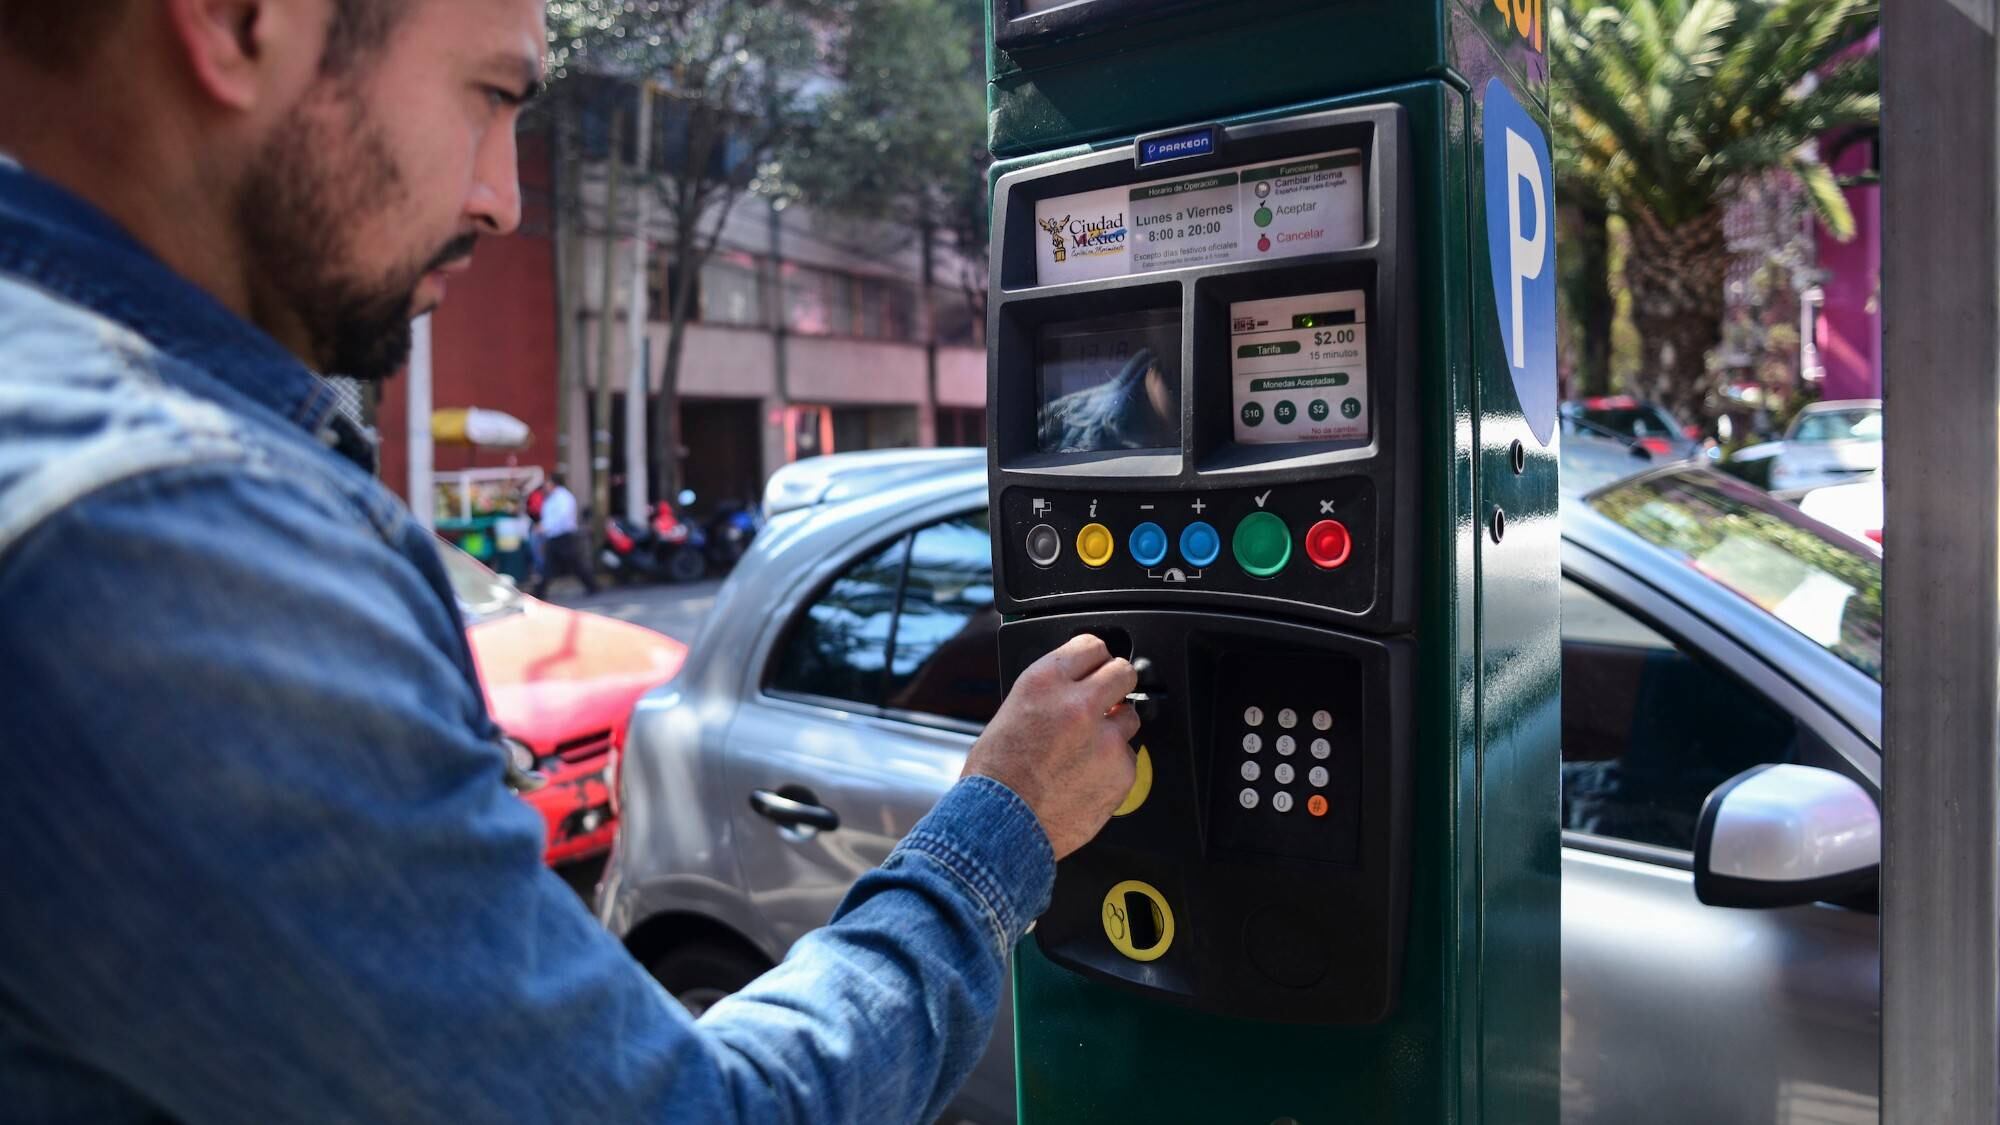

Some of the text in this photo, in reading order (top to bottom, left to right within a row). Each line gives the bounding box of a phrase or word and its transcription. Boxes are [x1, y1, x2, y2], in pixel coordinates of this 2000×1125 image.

[1159, 138, 1209, 153] PARKEON
[1280, 164, 1319, 176] Funciones
[1275, 171, 1343, 188] Cambiar Idioma
[1149, 187, 1173, 196] Horario
[1184, 179, 1218, 192] Operación
[1136, 204, 1233, 227] Lunes a Viernes
[1276, 202, 1317, 216] Aceptar
[1069, 213, 1123, 234] Ciudad
[1149, 221, 1221, 242] 8:00 a 20:00
[1276, 229, 1325, 243] Cancelar
[1071, 231, 1126, 249] México
[1134, 241, 1238, 262] Excepto días festivos oficiales
[1506, 127, 1546, 369] P
[1314, 330, 1355, 346] $2.00
[1257, 346, 1280, 355] Tarifa
[1310, 349, 1358, 360] 15 minutos
[1263, 377, 1335, 389] Monedas Aceptadas
[1244, 403, 1355, 418] $10 $5 $2 $1
[1250, 709, 1256, 722] 1
[1284, 711, 1290, 720] 2
[1248, 736, 1323, 751] 4 5 6
[1281, 767, 1287, 776] 8
[1315, 770, 1321, 779] 9
[1243, 792, 1321, 812] C 0 #
